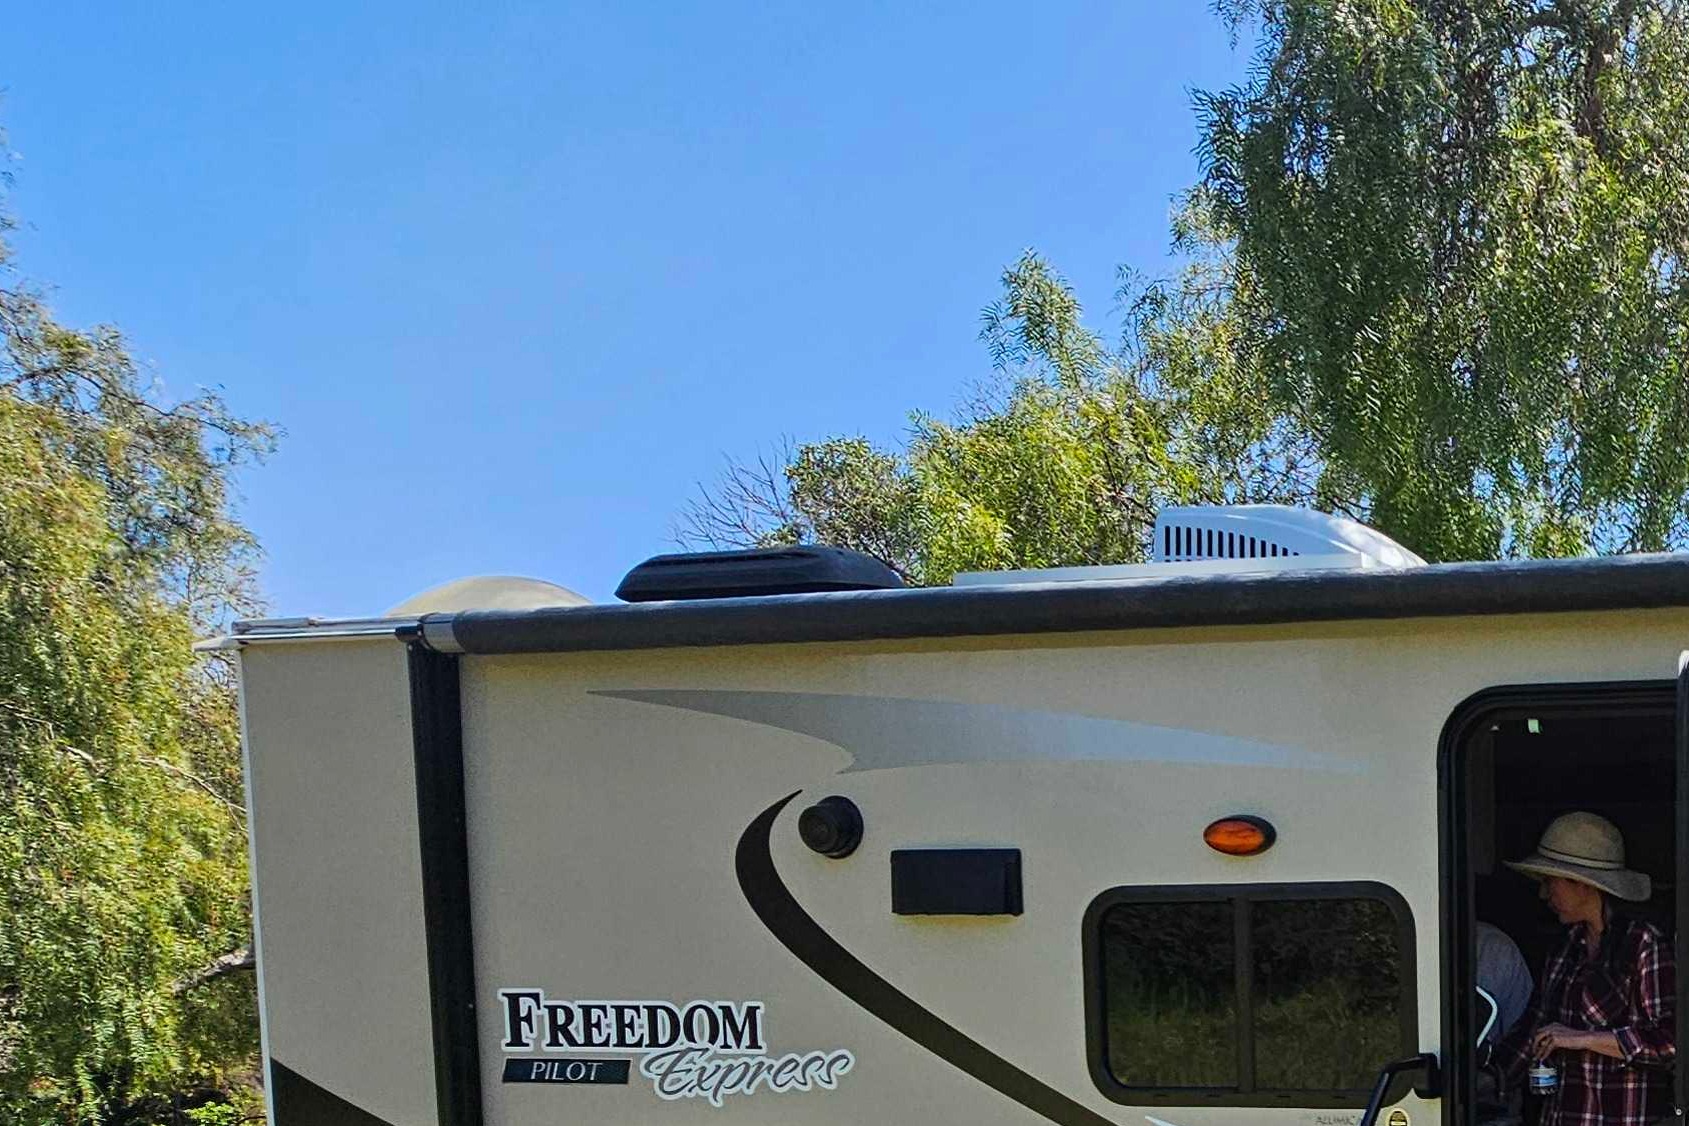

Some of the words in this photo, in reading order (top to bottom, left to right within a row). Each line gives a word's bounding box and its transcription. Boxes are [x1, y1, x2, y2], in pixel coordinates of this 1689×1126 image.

[500, 990, 764, 1051] FREEDOM
[530, 1061, 603, 1082] PILOT
[643, 1047, 852, 1104] Express
